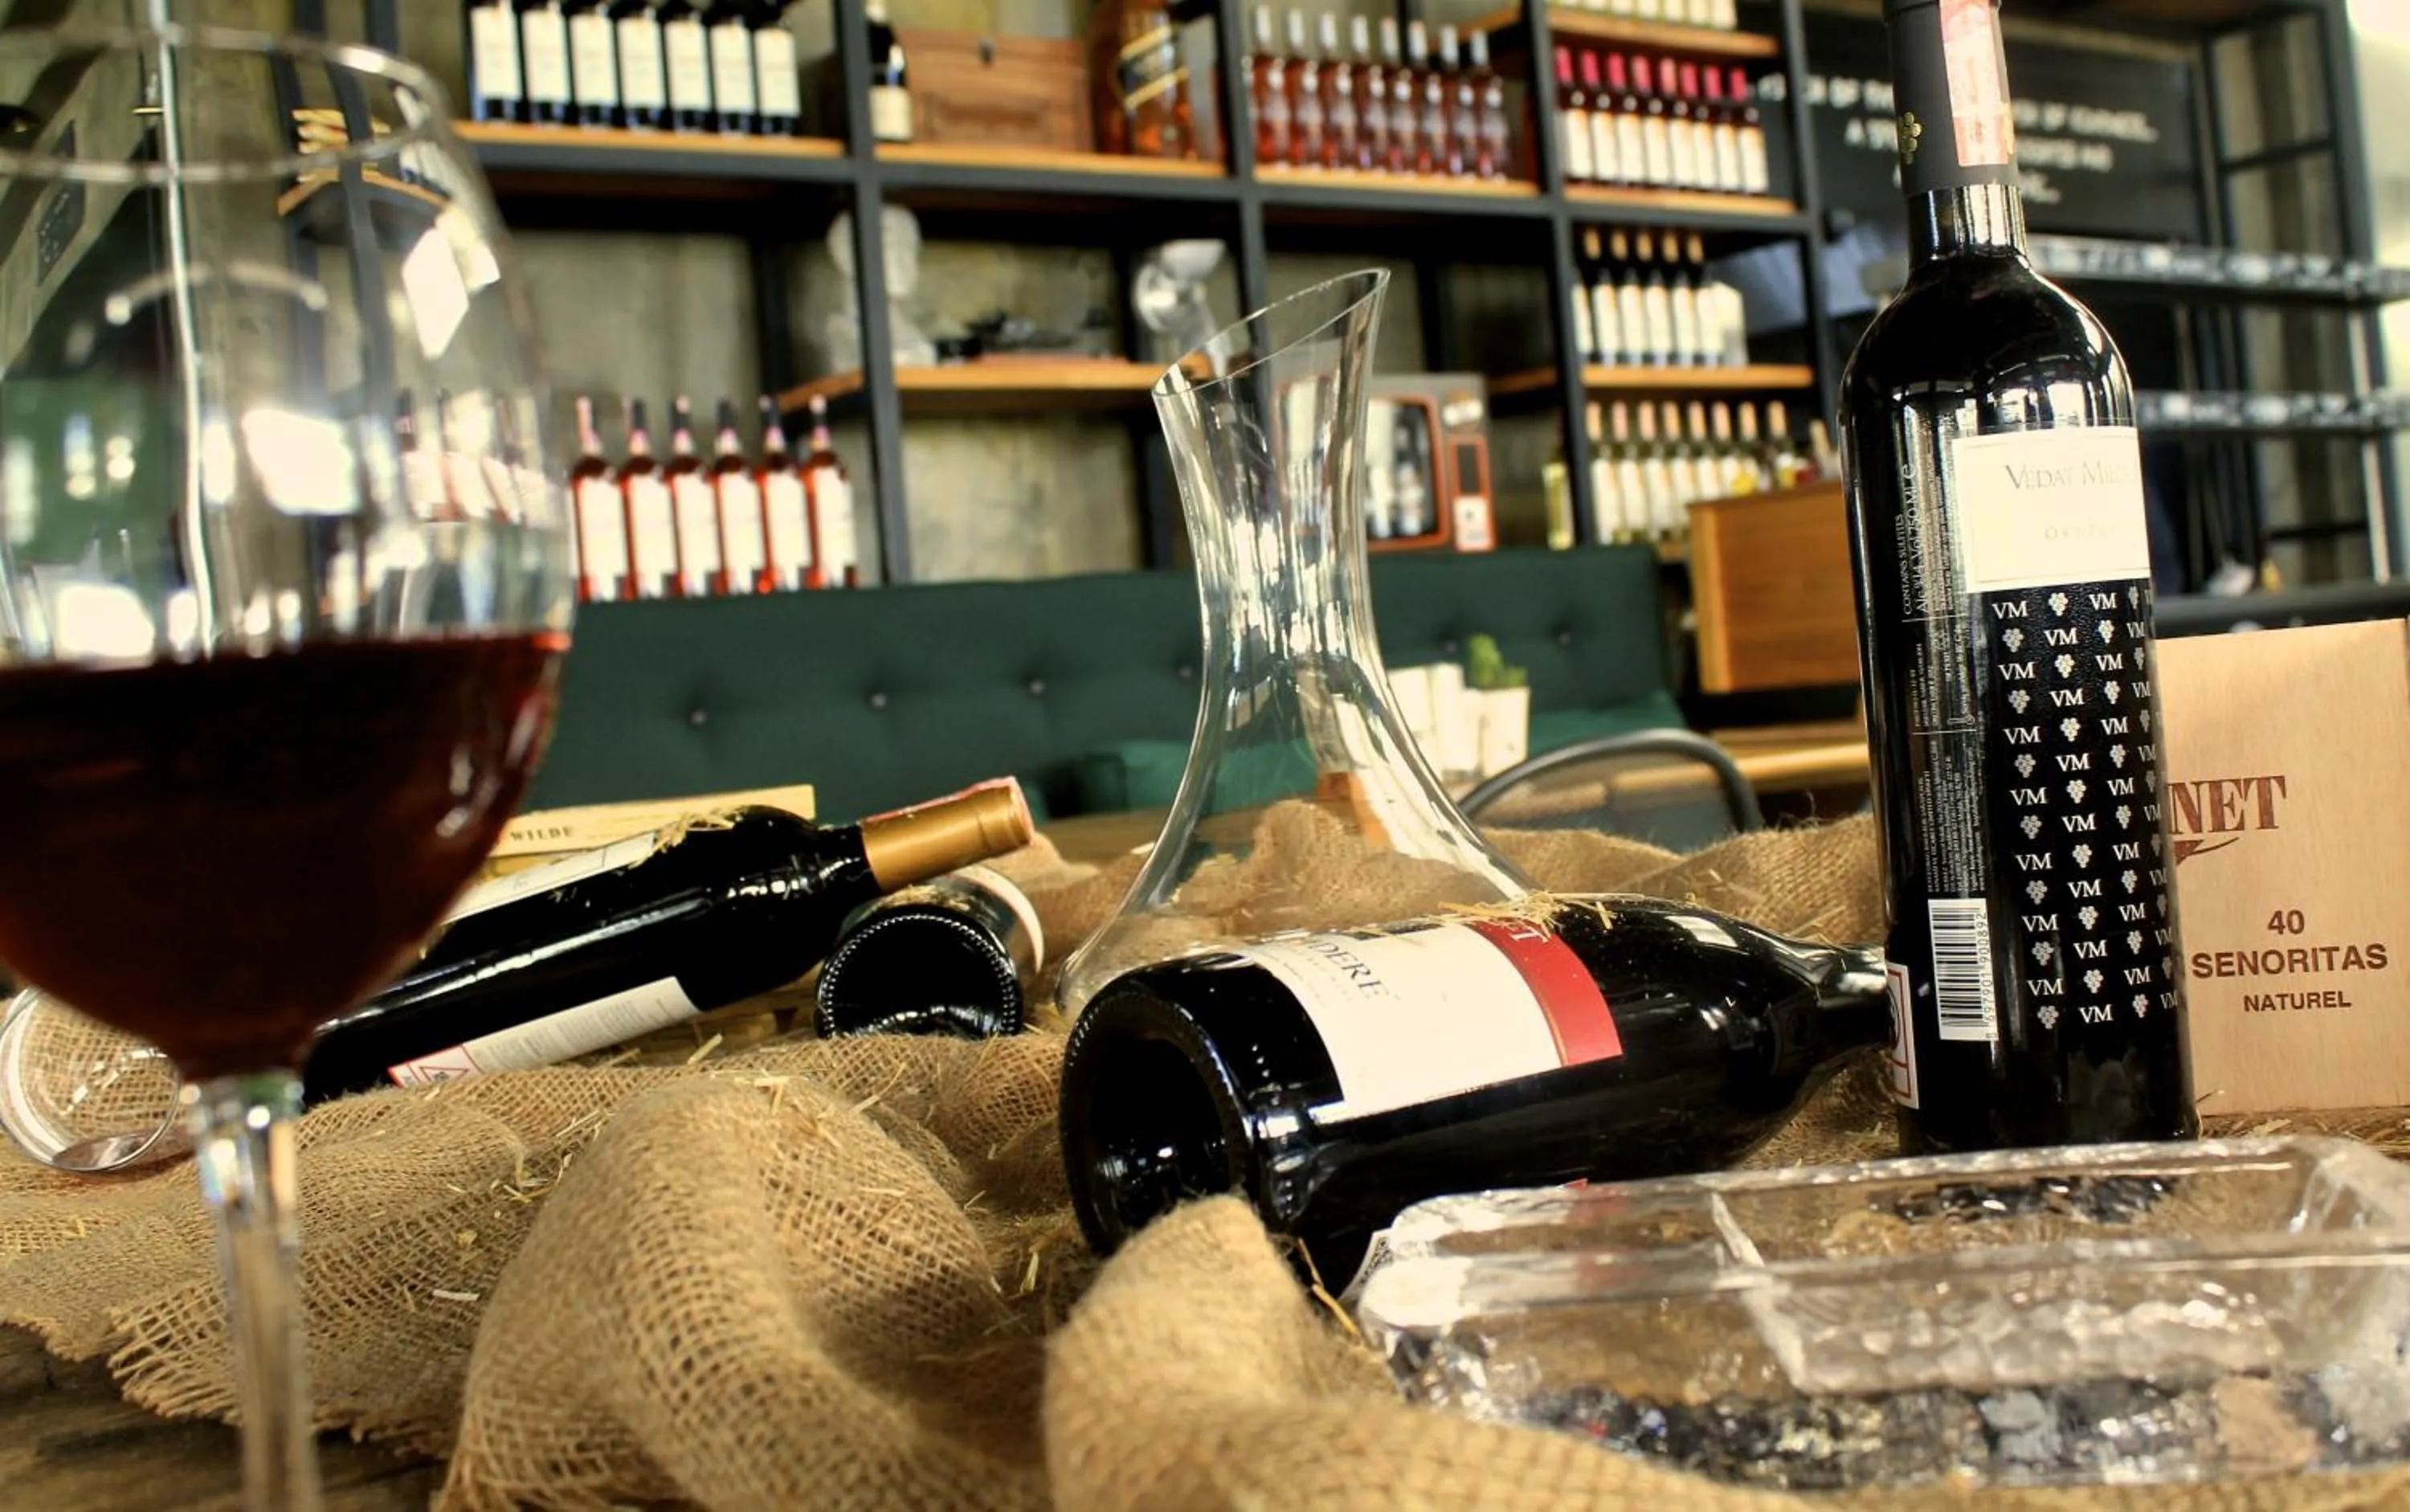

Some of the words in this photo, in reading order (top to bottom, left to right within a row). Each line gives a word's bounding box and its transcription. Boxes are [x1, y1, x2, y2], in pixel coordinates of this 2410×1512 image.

[1992, 600, 2028, 619] VM
[2089, 593, 2117, 610] VM
[2044, 627, 2078, 646] VM
[1998, 661, 2035, 680] VM
[2095, 653, 2122, 671] VM
[2049, 688, 2085, 707] VM
[2004, 726, 2041, 745] VM
[2101, 717, 2128, 735] VM
[2056, 753, 2089, 771] VM
[2010, 787, 2047, 805] VM
[2107, 778, 2134, 795] VM
[509, 826, 574, 843] WILDE
[2062, 814, 2095, 832] VM
[2016, 852, 2052, 870] VM
[2113, 842, 2138, 860] VM
[2068, 879, 2102, 897] VM
[2023, 914, 2058, 931] VM
[2119, 903, 2145, 921] VM
[2267, 909, 2305, 935] 40
[1976, 913, 1991, 964] 900892
[2073, 940, 2107, 958] VM
[2191, 943, 2388, 979] SENORITAS
[2028, 978, 2063, 995] VM
[2124, 966, 2150, 985] VM
[2080, 1004, 2113, 1023] VM
[2244, 991, 2352, 1012] NATUREL
